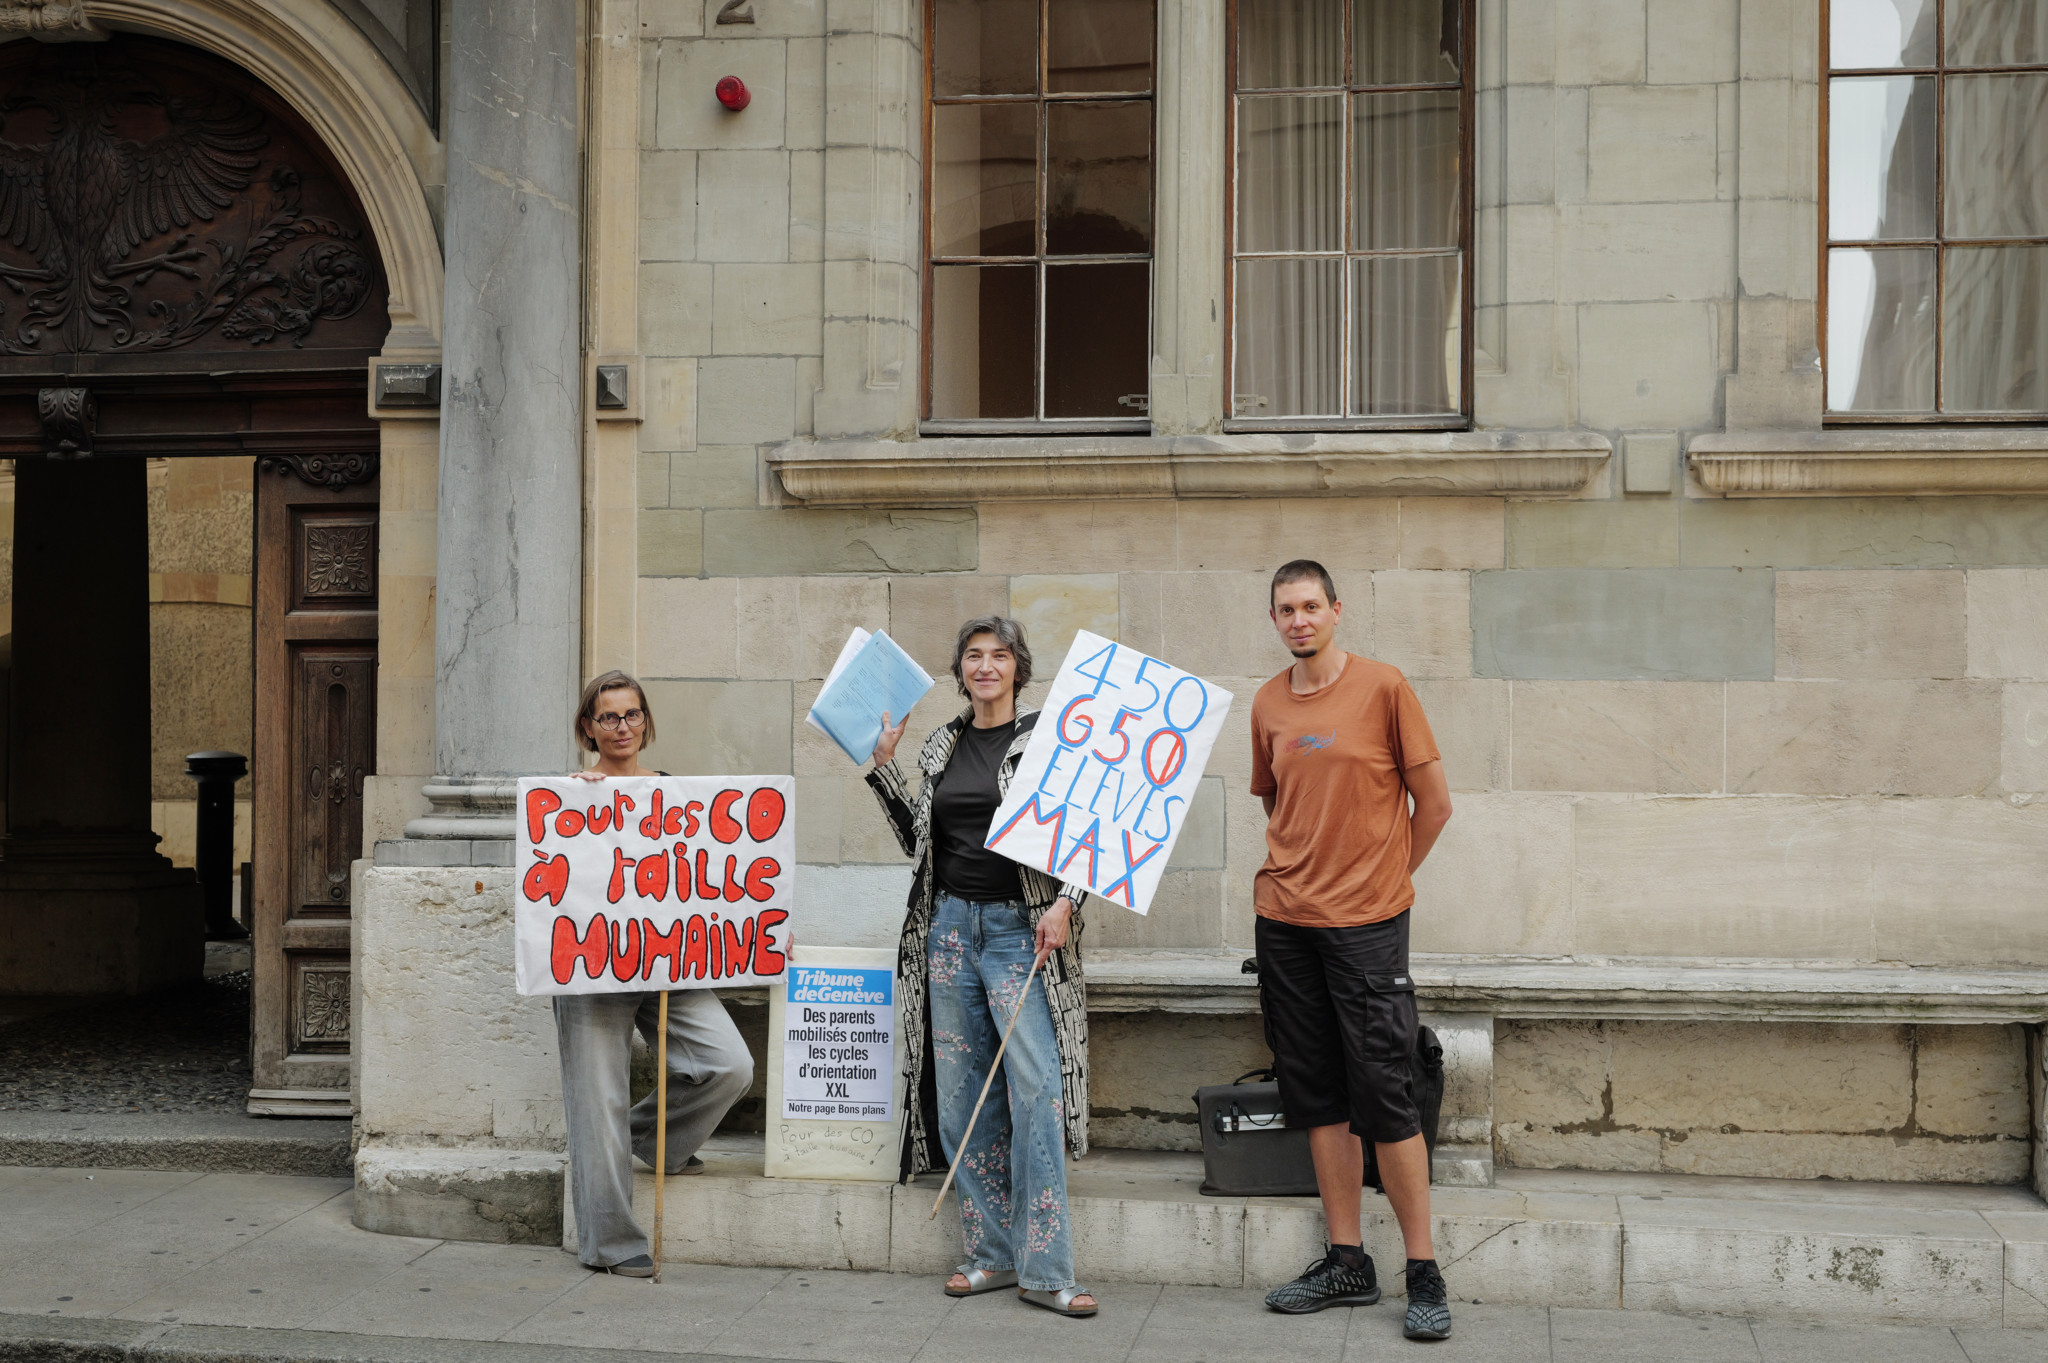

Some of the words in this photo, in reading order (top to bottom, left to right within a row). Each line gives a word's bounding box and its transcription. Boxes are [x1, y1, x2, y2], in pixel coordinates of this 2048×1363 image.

[1074, 643, 1208, 733] 450
[1038, 744, 1185, 842] ELEVES
[526, 787, 636, 844] Pour
[639, 788, 704, 840] des
[709, 787, 786, 844] CO
[986, 792, 1164, 908] MAX
[523, 849, 570, 906] à
[797, 970, 864, 987] Tribune
[803, 1008, 826, 1023] Des
[830, 1010, 875, 1027] parents
[788, 1026, 847, 1042] mobilisés
[850, 1029, 889, 1043] contre
[809, 1044, 826, 1059] les
[830, 1045, 869, 1063] cycles
[825, 1082, 849, 1098] XXL
[788, 1103, 812, 1112] Notre
[815, 1105, 836, 1115] page
[838, 1104, 860, 1114] Bons
[862, 1105, 886, 1116] plans
[780, 1124, 814, 1144] Pour
[824, 1126, 842, 1138] des
[850, 1127, 874, 1144] CO
